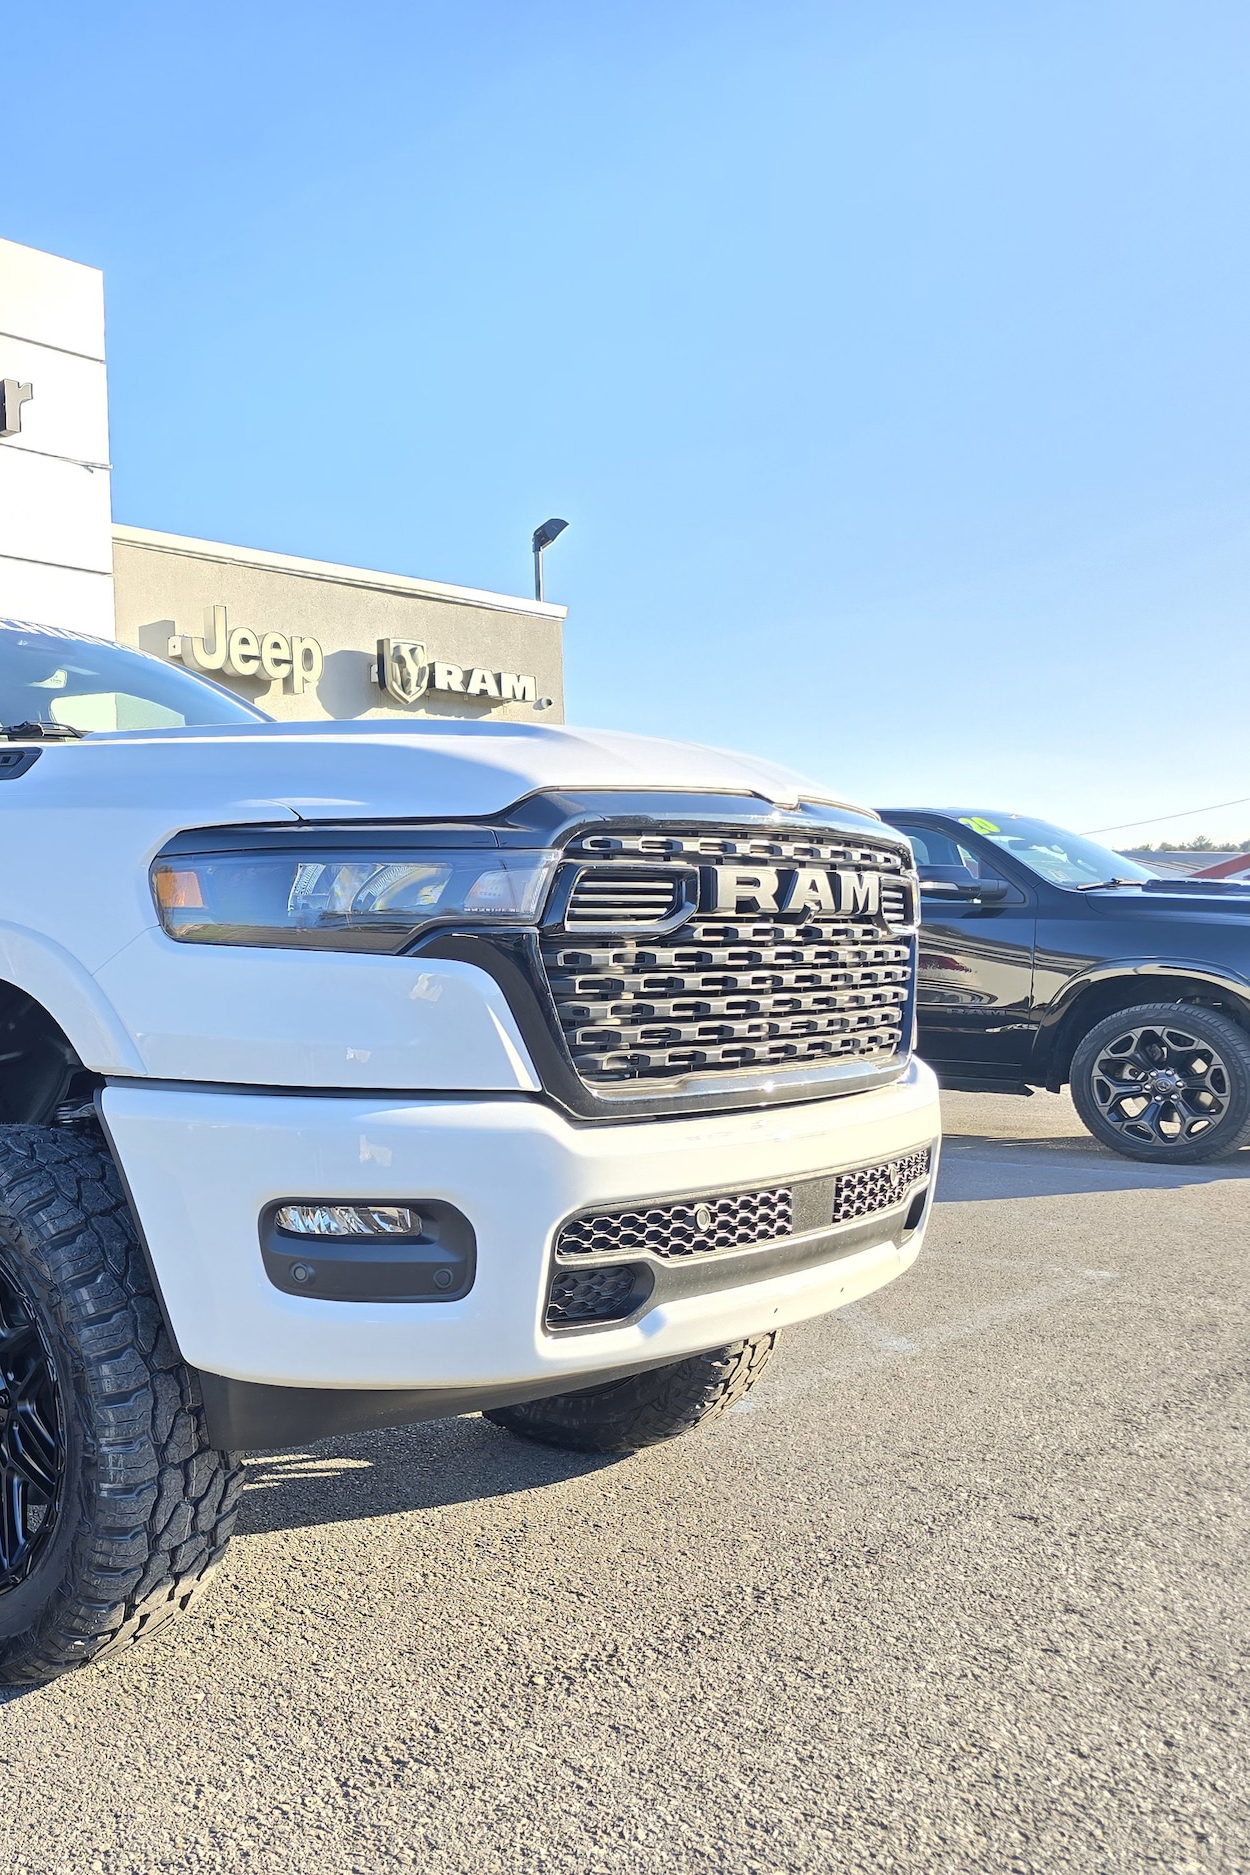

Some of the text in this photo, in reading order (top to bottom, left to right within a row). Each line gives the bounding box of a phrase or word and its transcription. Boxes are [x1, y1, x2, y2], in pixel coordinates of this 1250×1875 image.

[182, 605, 324, 694] Jeep
[432, 662, 538, 702] RAM
[958, 816, 1000, 835] 20
[711, 865, 879, 915] RAM
[946, 1007, 1006, 1016] RAM
